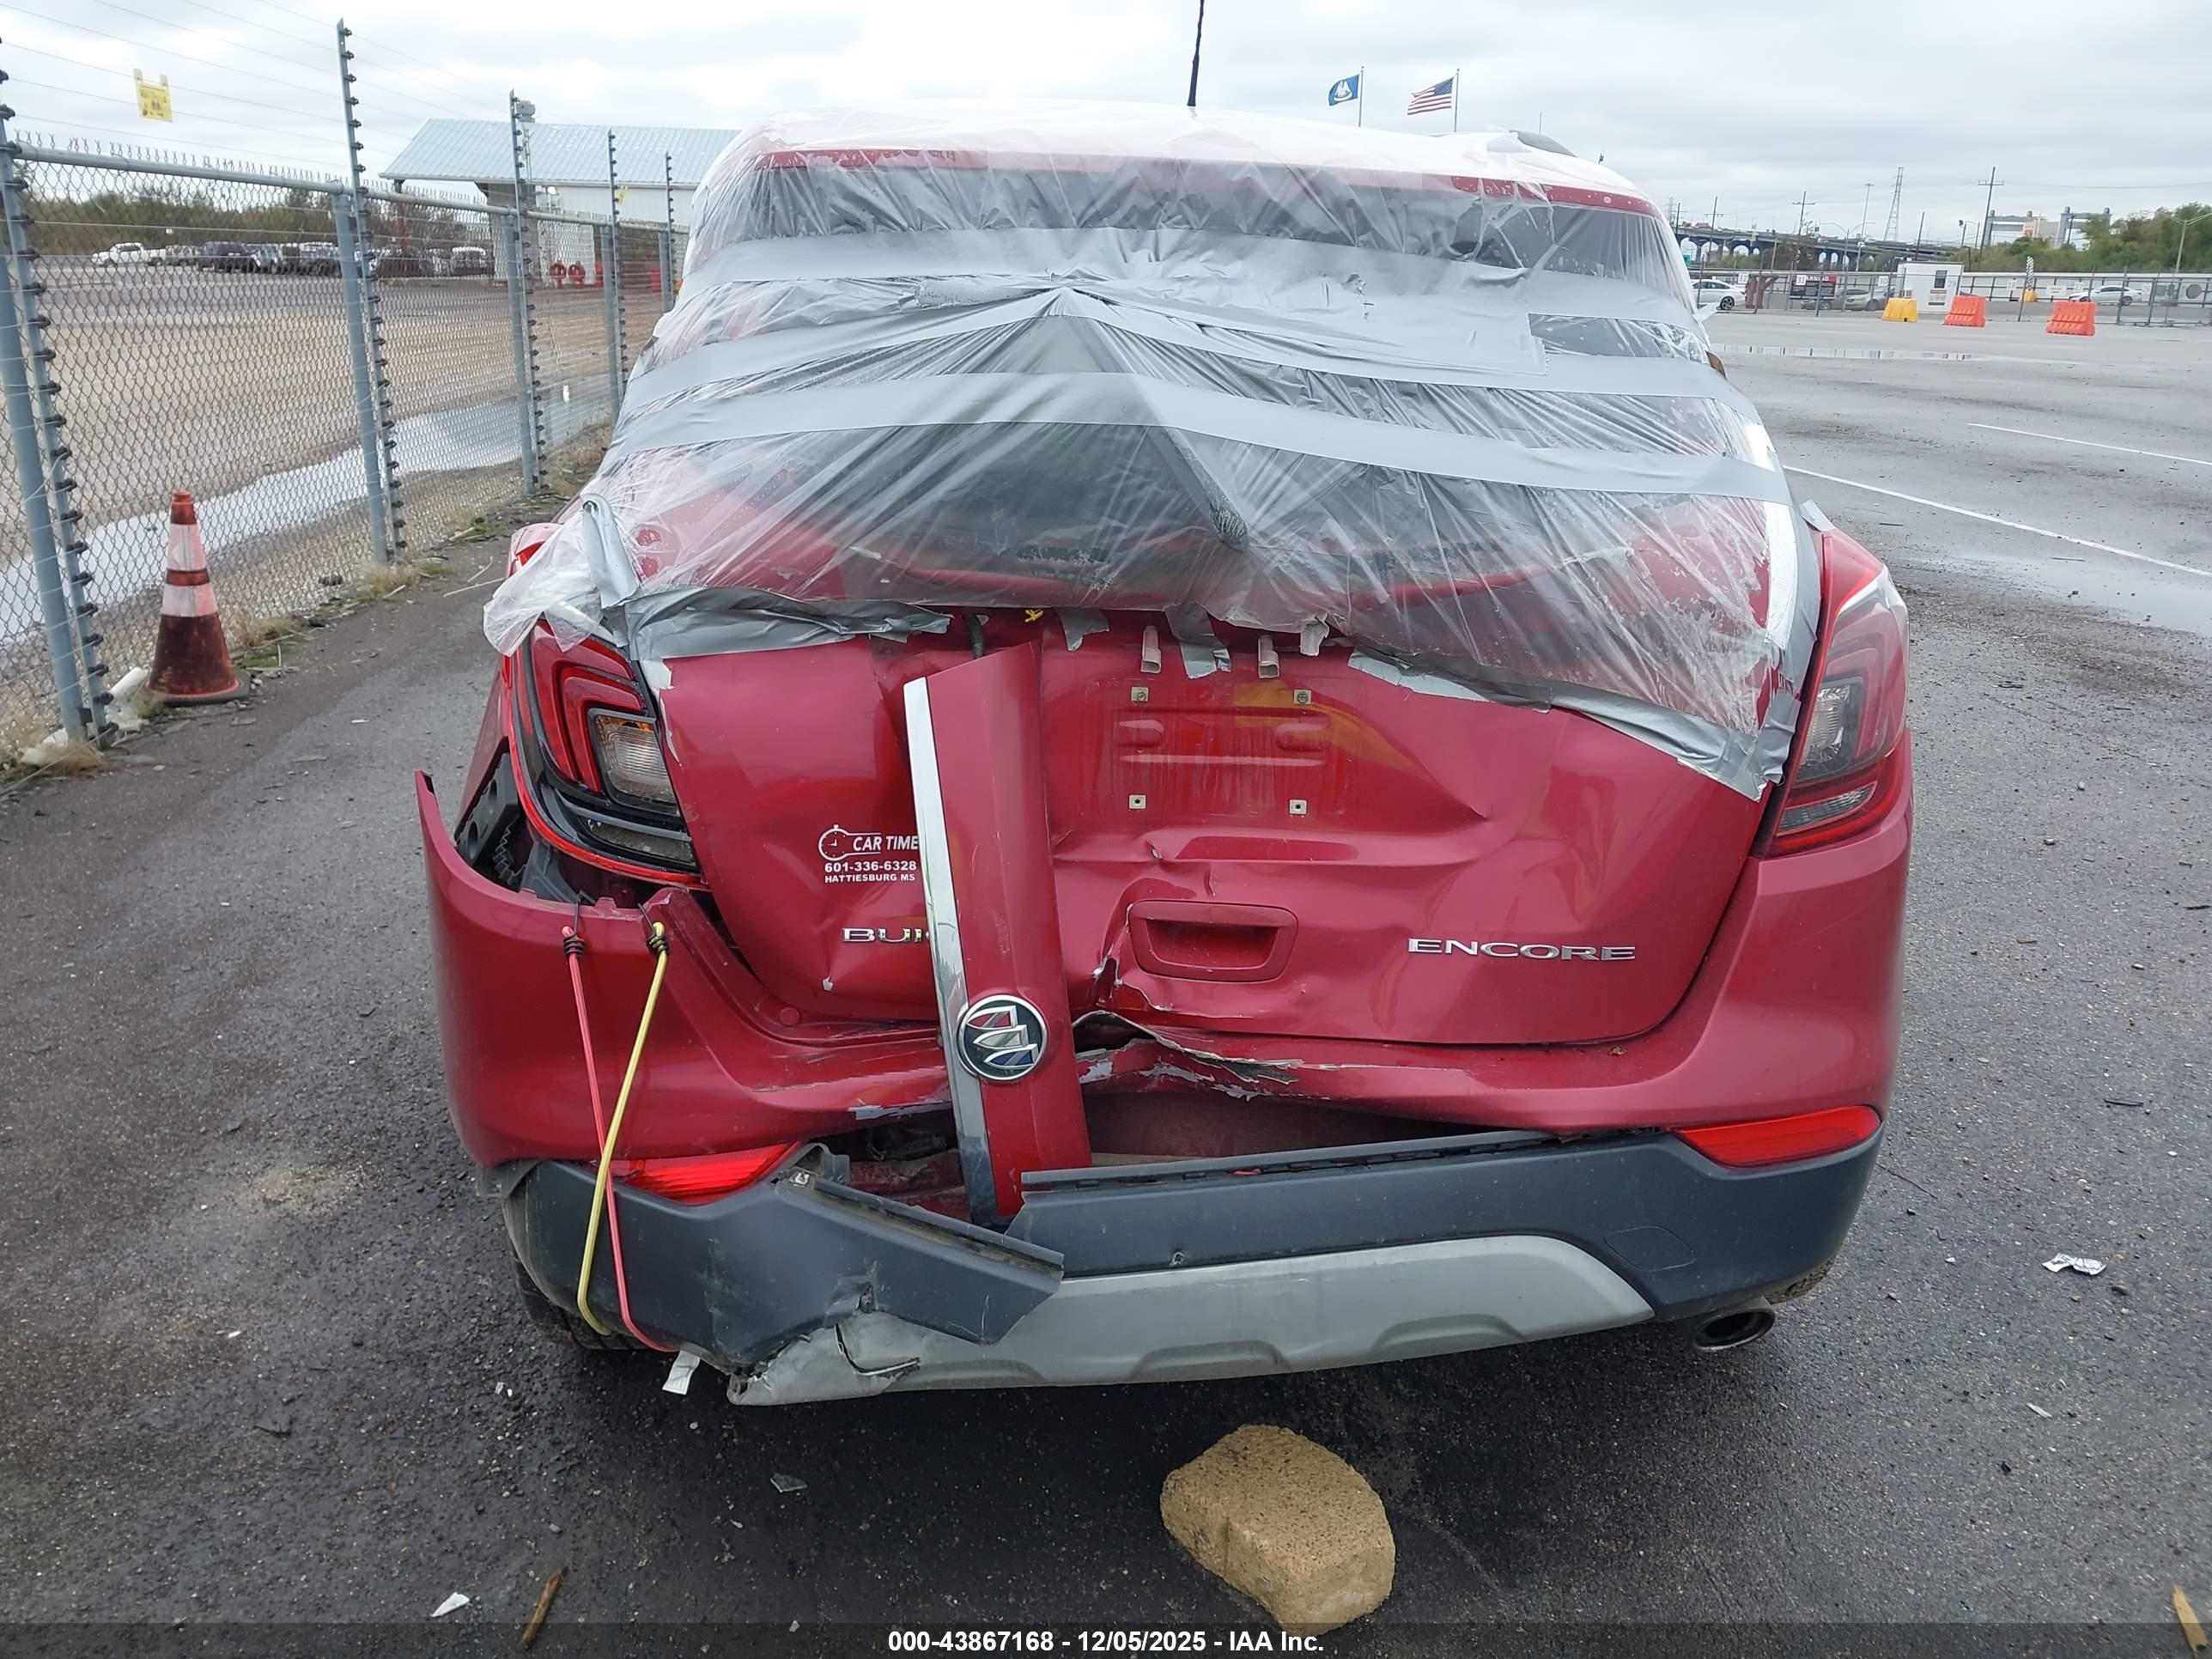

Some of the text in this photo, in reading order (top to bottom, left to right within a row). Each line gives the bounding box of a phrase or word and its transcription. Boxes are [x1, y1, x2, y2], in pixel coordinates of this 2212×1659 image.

[1797, 276, 1806, 284] 31
[1879, 276, 1888, 285] 30
[853, 835, 918, 852] CAR TIME
[824, 860, 917, 873] 601-336-6328
[824, 873, 915, 884] HATTIESBURG MS
[842, 927, 929, 943] BUI
[1407, 937, 1636, 961] ENCORE
